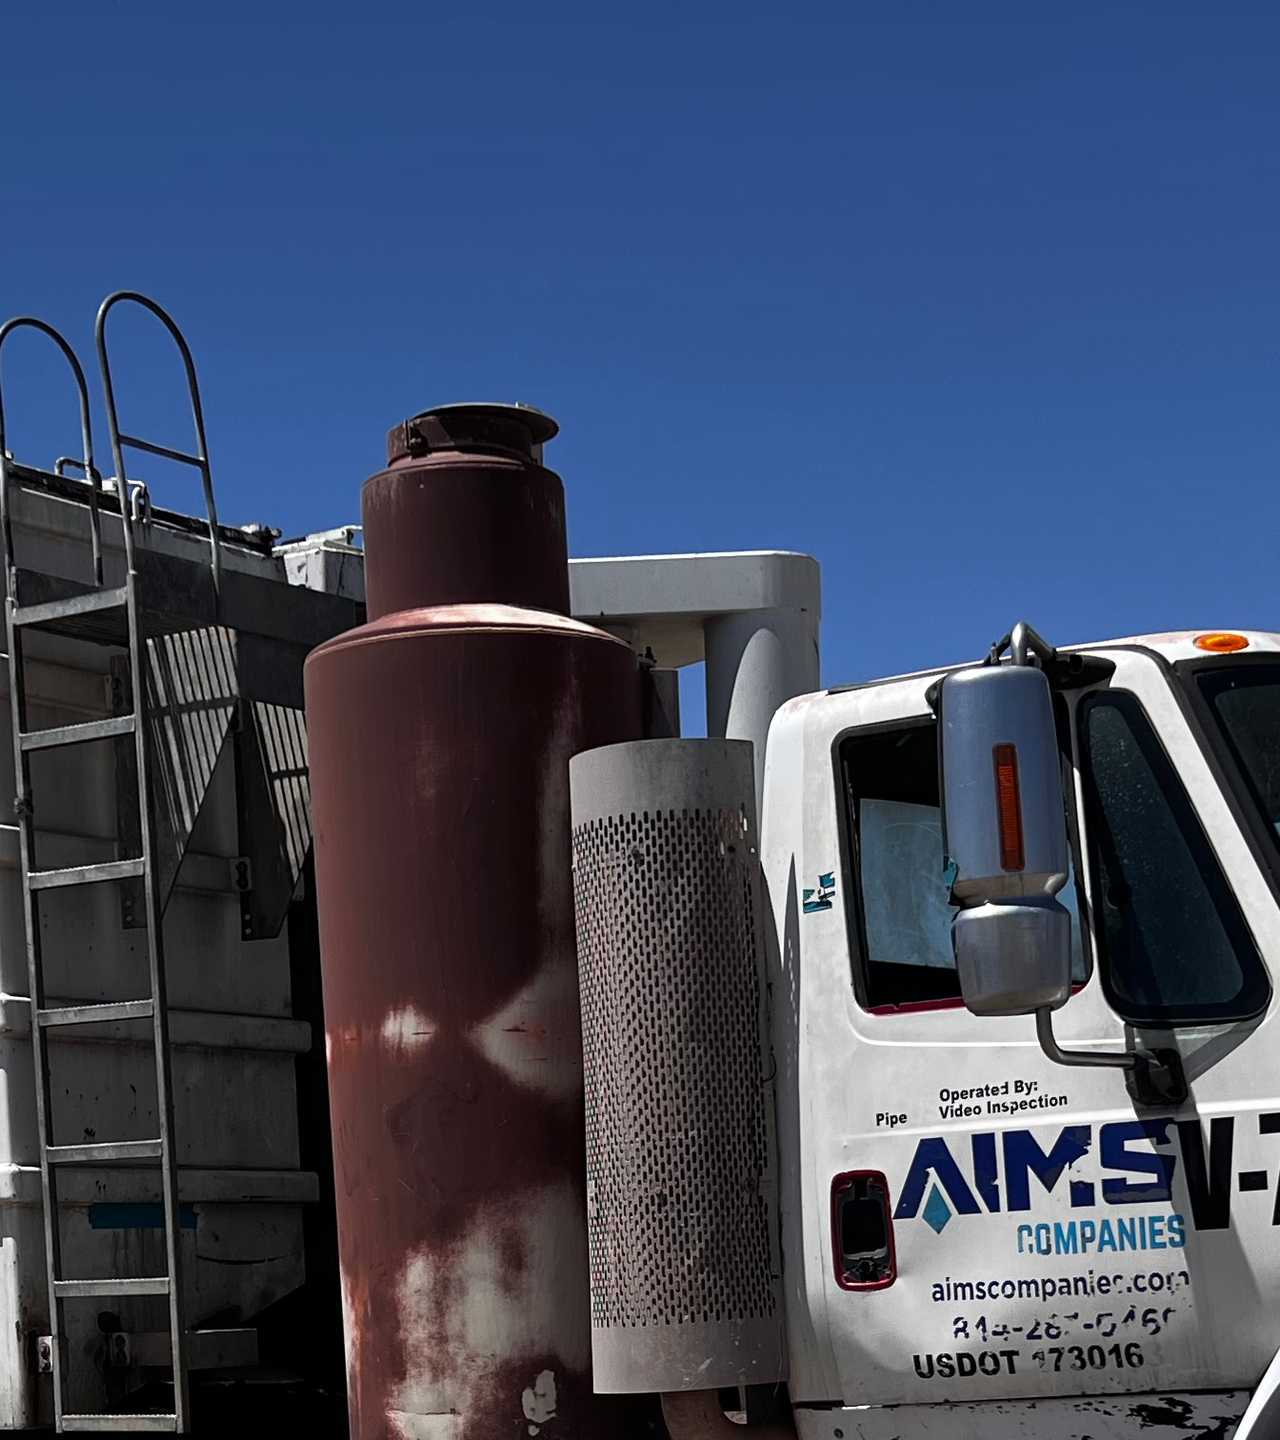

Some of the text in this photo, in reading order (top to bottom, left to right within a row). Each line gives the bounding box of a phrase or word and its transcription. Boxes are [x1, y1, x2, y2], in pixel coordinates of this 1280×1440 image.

[939, 1079, 1039, 1105] Operated By:
[875, 1093, 1068, 1128] Pipe Video Inspection
[892, 1117, 1177, 1220] AIMS
[1017, 1213, 1186, 1255] COMPANIES
[913, 1349, 1020, 1380] USDOT
